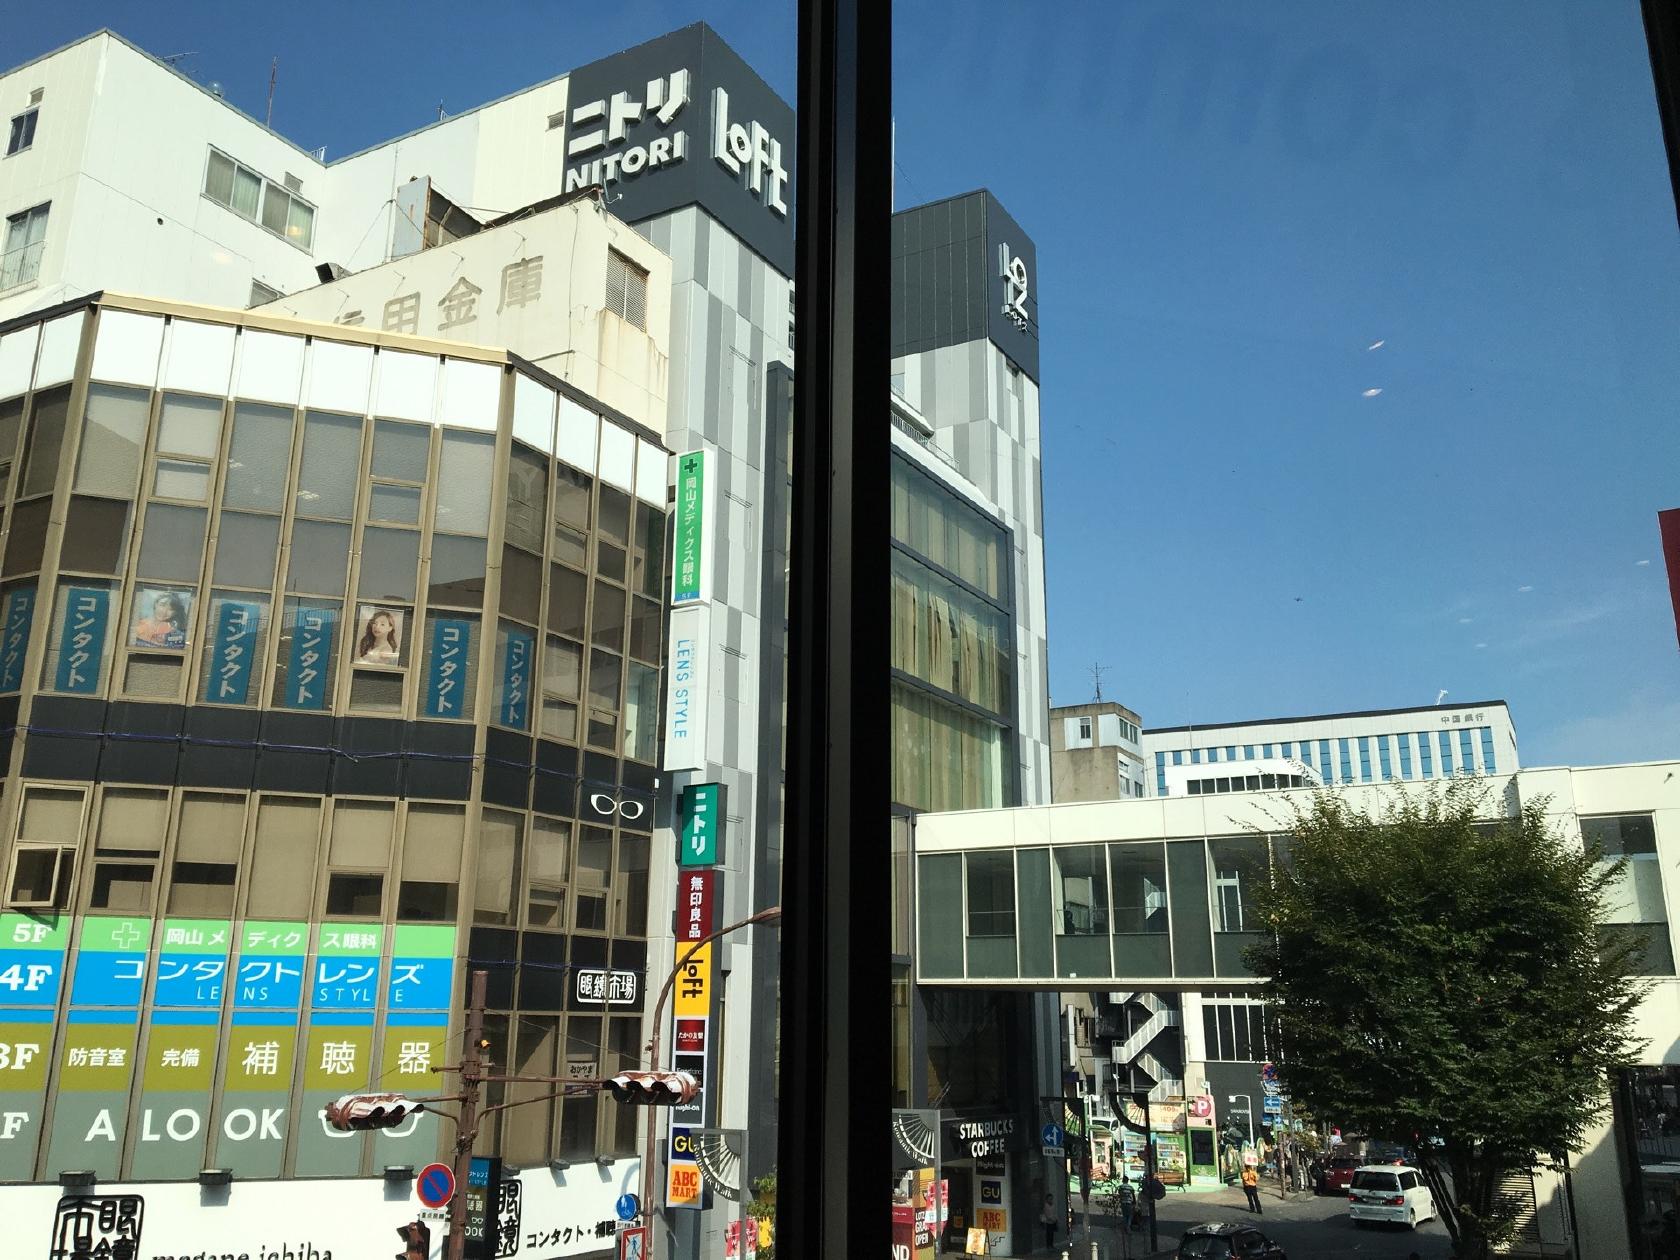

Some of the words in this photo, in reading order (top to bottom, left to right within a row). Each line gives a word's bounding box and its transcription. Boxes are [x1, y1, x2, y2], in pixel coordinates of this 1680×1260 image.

[568, 68, 690, 157] ニトリ
[565, 130, 688, 193] NITORI
[682, 476, 697, 587] 岡山メディクス眼科
[1, 597, 28, 688] コンタクト
[68, 597, 97, 688] コンタクト
[219, 608, 249, 698] コンタクト
[297, 616, 322, 704] コンタクト
[437, 627, 460, 713] コンタクト
[675, 639, 690, 682] LENS
[508, 640, 525, 724] コンタクト
[674, 688, 689, 739] STYLE
[691, 792, 707, 856] ニトリ
[689, 876, 704, 938] 無印良品
[12, 924, 53, 943] 5F
[0, 964, 53, 992] 4F
[114, 958, 424, 986] コンタクトレンズ
[579, 973, 635, 1000] 眼鏡市場
[197, 986, 268, 1000] LENS
[1197, 1100, 1208, 1114] P
[959, 1119, 1014, 1140] STARBUCKS
[971, 1138, 1005, 1158] COFFEE
[672, 1171, 698, 1187] ABC
[672, 1186, 698, 1200] MART
[982, 1186, 1000, 1199] GU
[983, 1211, 1001, 1222] ABC
[527, 1220, 616, 1249] コンタクト・補聴
[915, 1233, 929, 1246] OPEN
